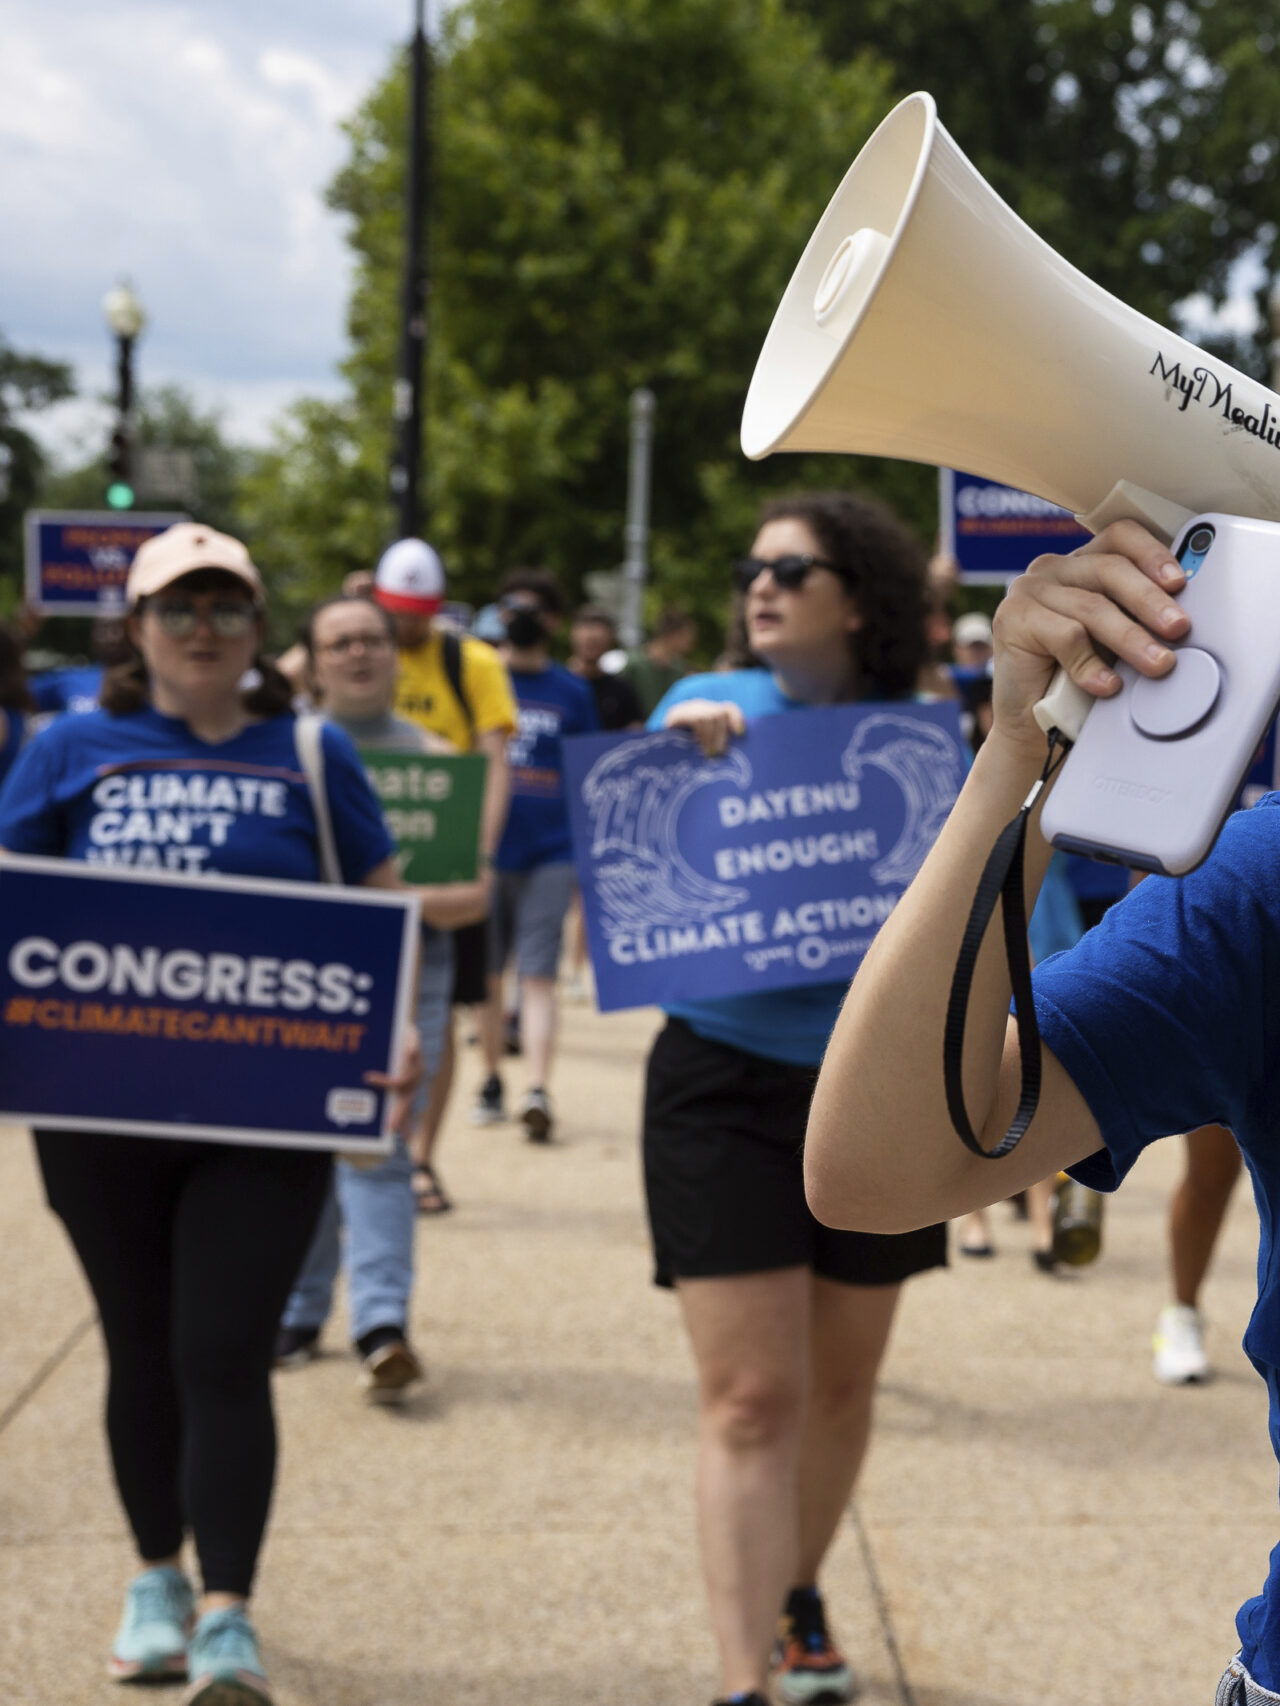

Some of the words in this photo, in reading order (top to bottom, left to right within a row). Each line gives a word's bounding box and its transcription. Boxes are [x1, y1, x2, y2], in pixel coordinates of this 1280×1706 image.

[92, 773, 288, 818] CLIMATE
[718, 782, 861, 829] DAYENU
[88, 809, 237, 846] CAN'T
[609, 911, 767, 966] CLIMATE
[8, 936, 374, 1016] CONGRESS:
[4, 995, 366, 1053] #CLIMATECANTWAIT
